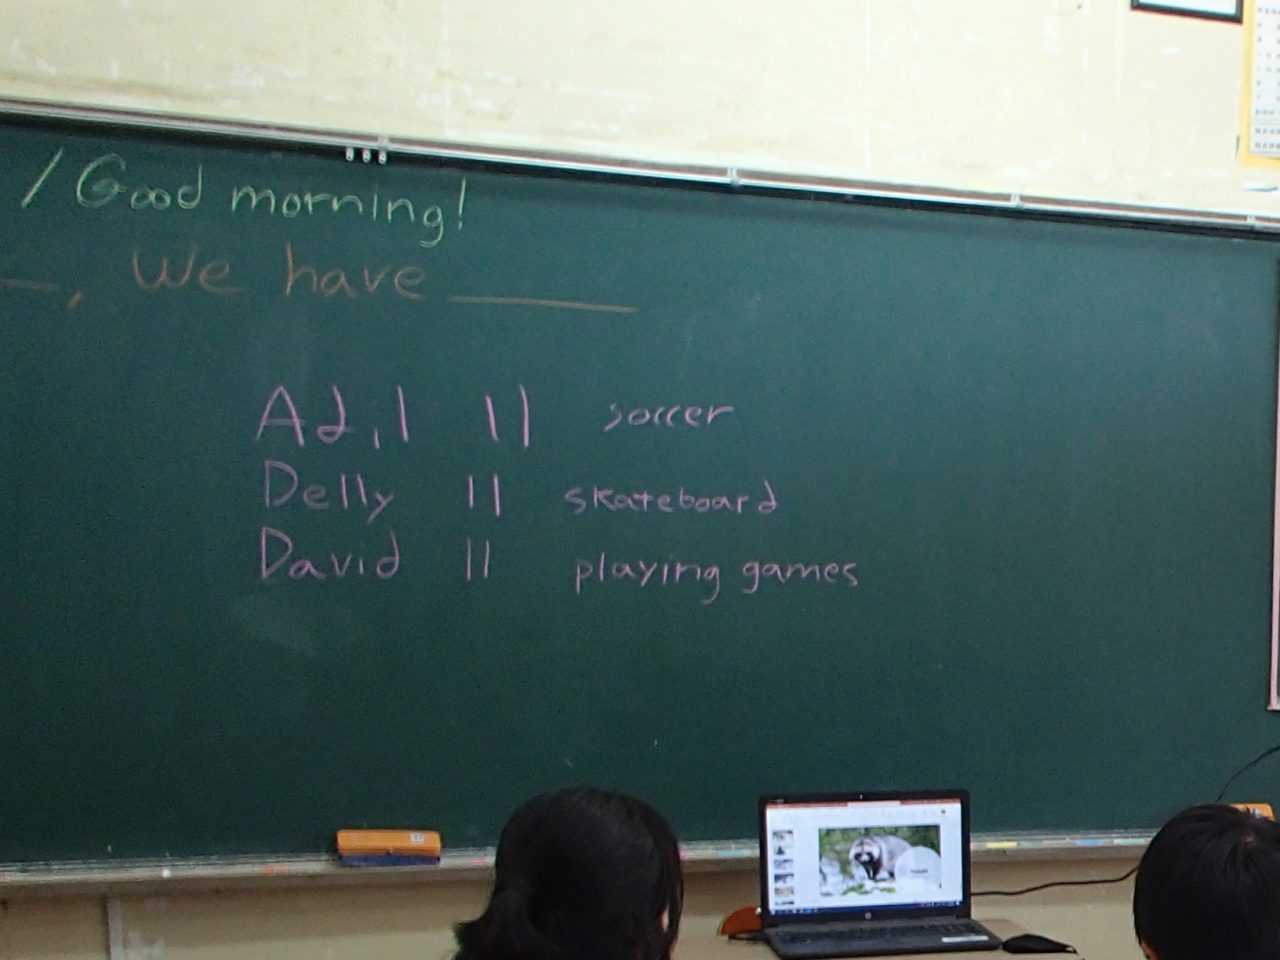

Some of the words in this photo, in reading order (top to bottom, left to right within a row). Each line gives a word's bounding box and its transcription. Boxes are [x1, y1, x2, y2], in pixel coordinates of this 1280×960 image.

[76, 152, 202, 209] Good
[231, 177, 467, 248] morning!
[132, 243, 244, 295] We
[285, 240, 425, 299] have
[603, 402, 735, 432] soccer
[265, 459, 395, 523] Delly
[564, 480, 778, 515] skateboard
[261, 526, 400, 579] David
[576, 552, 720, 605] playing
[742, 560, 858, 594] games
